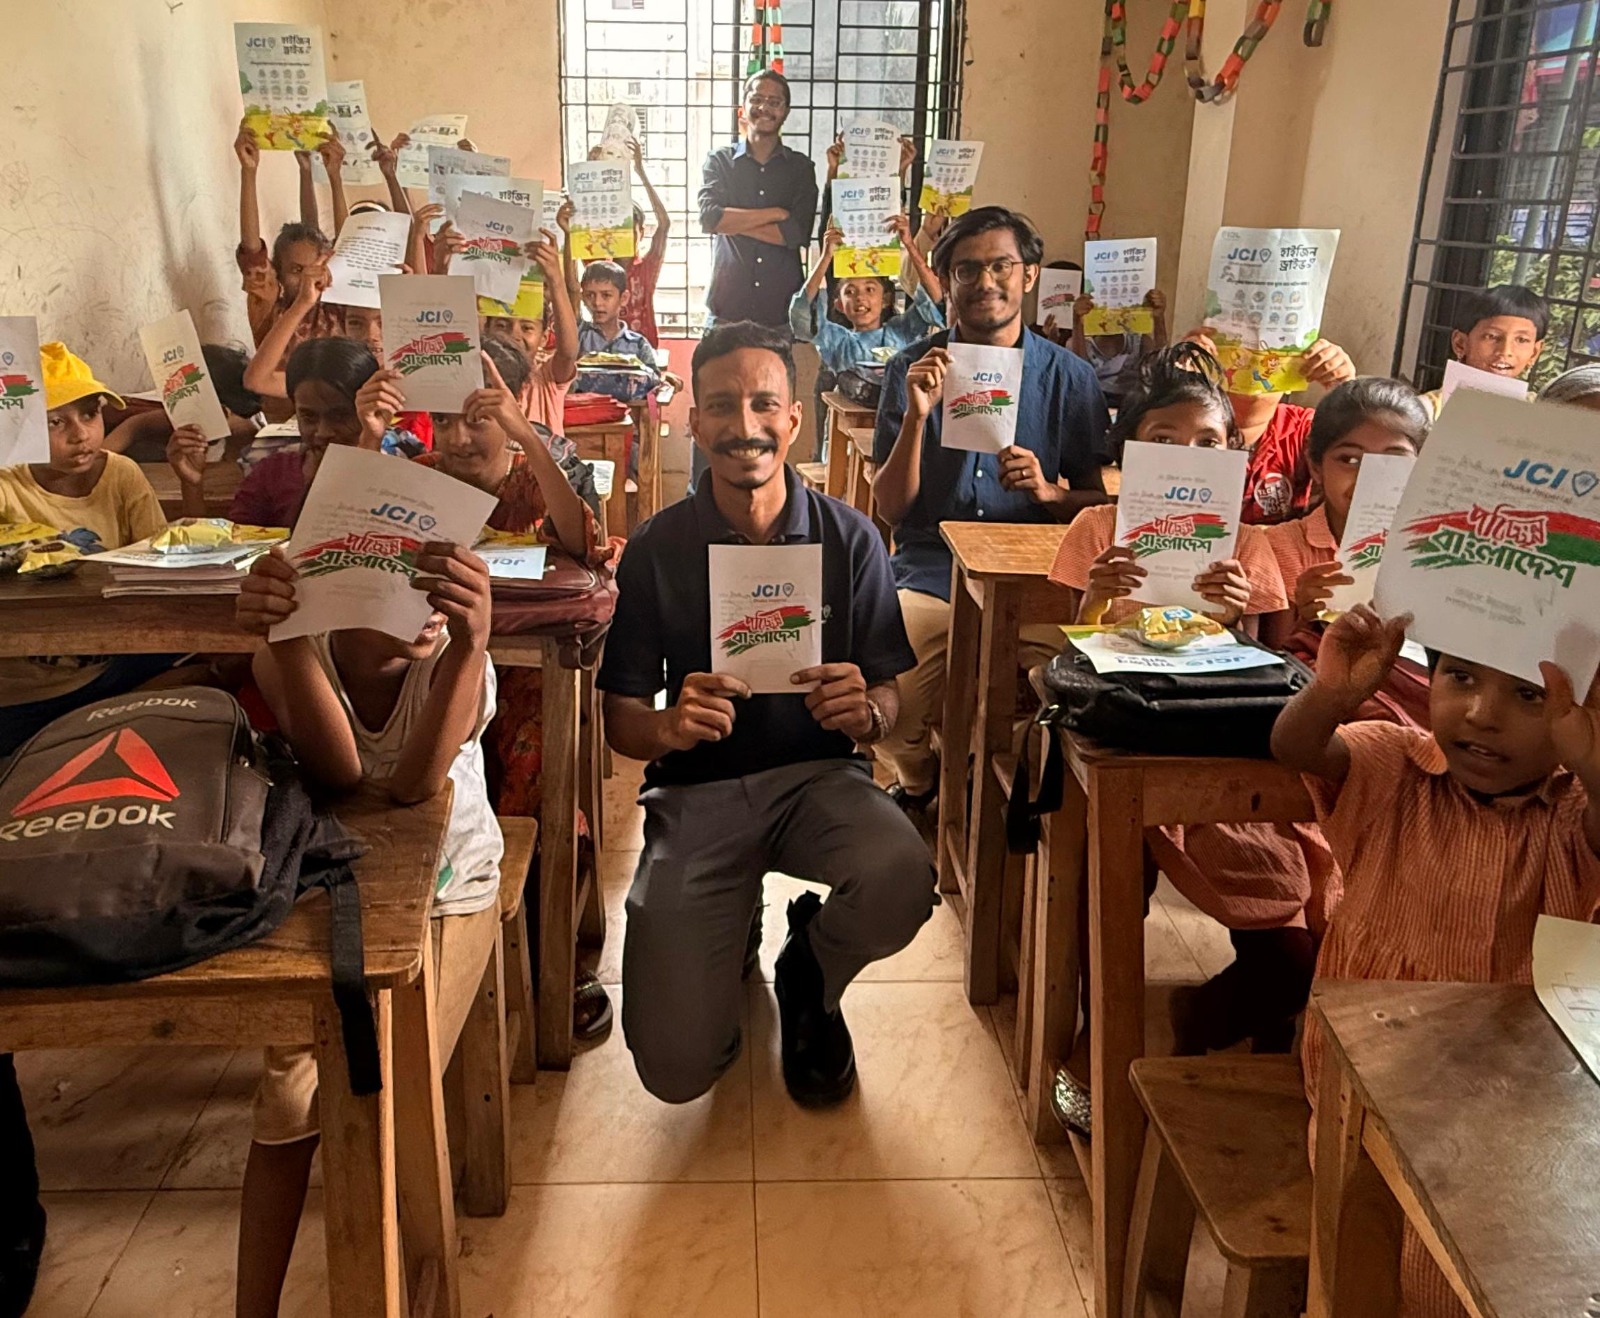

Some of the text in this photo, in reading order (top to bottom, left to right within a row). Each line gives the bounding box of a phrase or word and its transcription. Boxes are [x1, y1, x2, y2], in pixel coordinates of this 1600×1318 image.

[246, 37, 266, 48] JCI
[849, 127, 865, 135] JCI
[575, 172, 590, 181] JCI
[841, 190, 857, 199] JCI
[485, 221, 505, 232] JCI
[1094, 251, 1111, 261] JCI
[1227, 248, 1257, 262] JCI
[416, 311, 441, 323] JCI
[163, 348, 177, 364] JCI
[400, 353, 463, 367] বাংলাদেশ
[972, 372, 993, 382] JCI
[1503, 458, 1569, 489] JCI
[1164, 486, 1197, 502] JCI
[370, 502, 417, 524] JCI
[1138, 533, 1212, 554] বাংলাদেশ
[1429, 525, 1577, 588] বাংলাদেশ
[317, 549, 419, 581] বাংলাদেশ
[751, 584, 780, 598] JCI
[732, 629, 801, 644] বাংলাদেশ
[87, 696, 198, 722] Reebok
[0, 803, 177, 842] Reebok
